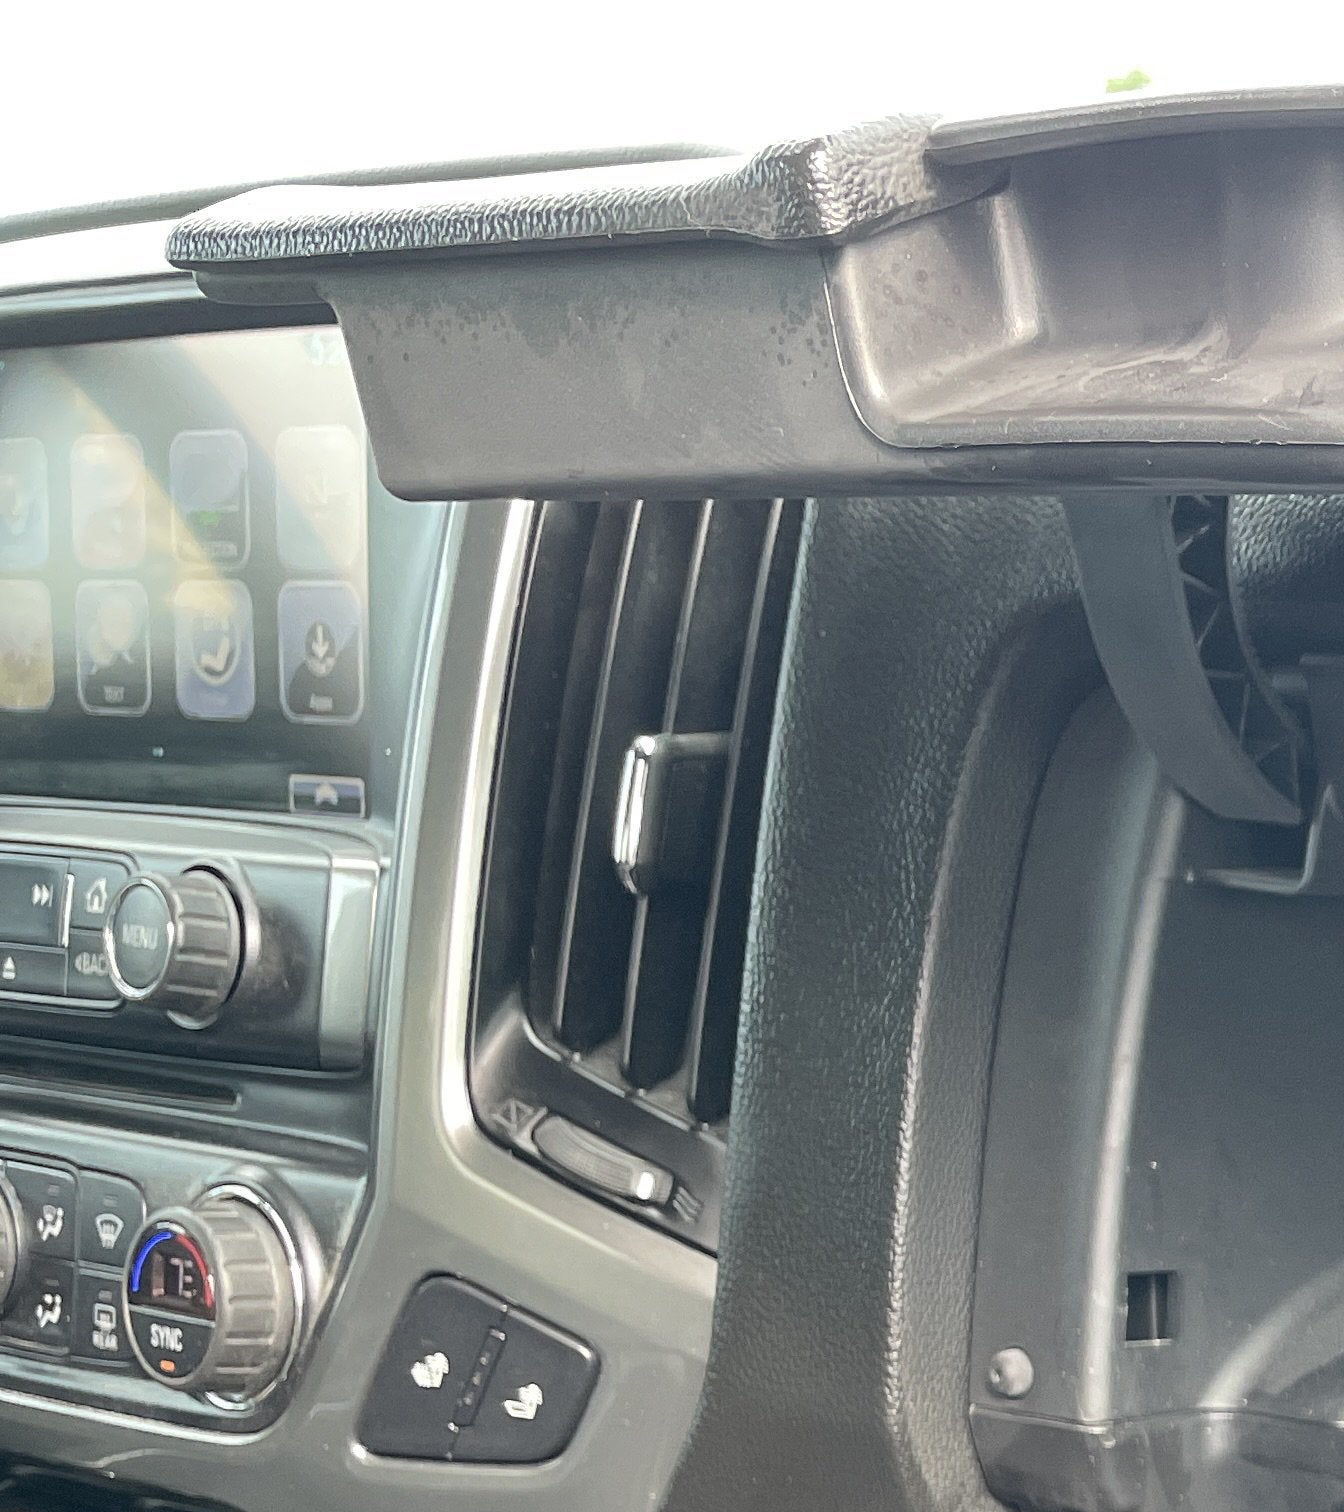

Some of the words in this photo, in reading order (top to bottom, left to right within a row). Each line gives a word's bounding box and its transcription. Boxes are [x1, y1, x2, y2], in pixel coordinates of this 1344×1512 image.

[122, 923, 159, 950] MENU
[83, 952, 110, 977] BAC
[150, 1323, 183, 1352] SYNC
